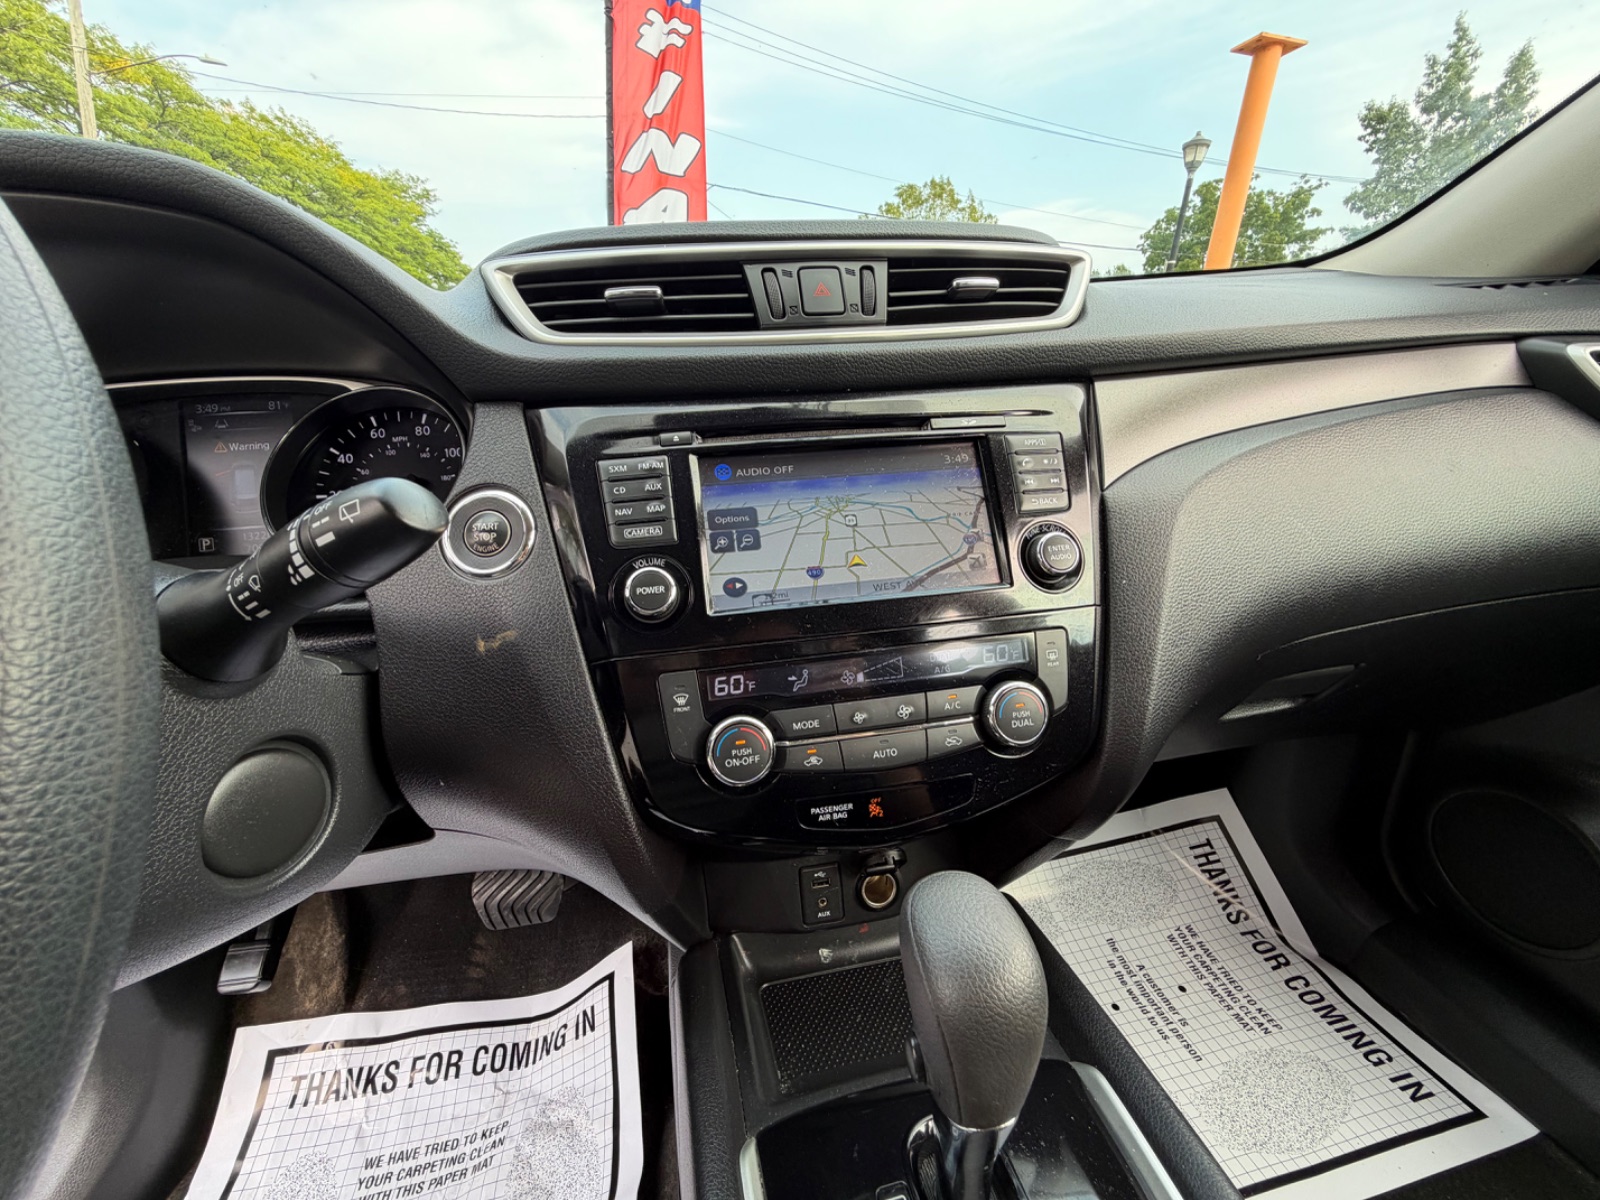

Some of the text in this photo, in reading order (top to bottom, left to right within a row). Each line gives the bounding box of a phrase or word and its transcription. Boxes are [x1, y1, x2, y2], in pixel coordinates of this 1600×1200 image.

[195, 404, 218, 414] 3:49
[370, 428, 386, 439] 60
[415, 426, 430, 436] 80
[229, 442, 270, 452] Warning
[337, 454, 353, 464] 40
[944, 454, 969, 464] 3:49
[608, 465, 627, 473] SXM
[736, 465, 794, 477] AUDIO OFF
[613, 486, 626, 494] CD
[645, 483, 662, 491] AUX
[615, 508, 633, 516] NAV
[647, 505, 666, 513] MAP
[715, 515, 750, 526] Options
[472, 522, 499, 532] START
[473, 532, 497, 541] STOP
[625, 528, 661, 538] CAMERA
[473, 542, 499, 552] ENGINE
[1048, 544, 1070, 552] ENTER
[632, 558, 666, 570] VOLUME
[636, 585, 665, 595] POWER
[872, 582, 901, 592] WEST
[673, 705, 690, 713] FRONT
[944, 701, 961, 710] A/C
[1012, 711, 1031, 719] PUSH
[792, 719, 820, 731] MODE
[1011, 718, 1034, 729] DUAL
[731, 747, 753, 757] PUSH
[873, 747, 898, 759] AUTO
[810, 802, 854, 816] PASSENGER
[818, 811, 848, 822] AIR BAG
[1166, 934, 1187, 958] WITH
[1186, 960, 1207, 981] THIS
[1203, 982, 1234, 1012] PAPER
[1189, 838, 1435, 1103] THANKS FOR COMING IN
[1174, 927, 1272, 1035] YOUR CARPETING CLEAN
[1185, 924, 1283, 1031] WE HAVE TRIED TO KEEP
[1106, 960, 1116, 969] in
[1114, 970, 1128, 986] the
[1126, 988, 1151, 1015] world
[1147, 1016, 1158, 1027] to
[1136, 963, 1189, 1027] A customer is
[1106, 938, 1203, 1062] the most important person
[288, 1004, 596, 1109] THANKS FOR COMING IN
[364, 1120, 509, 1171] WE HAVE TRIED TO KEEP
[357, 1136, 506, 1191] YOUR CARPETING CLEAN
[395, 1181, 426, 1200] THIS
[427, 1168, 468, 1191] PAPER
[471, 1155, 496, 1175] MAT
